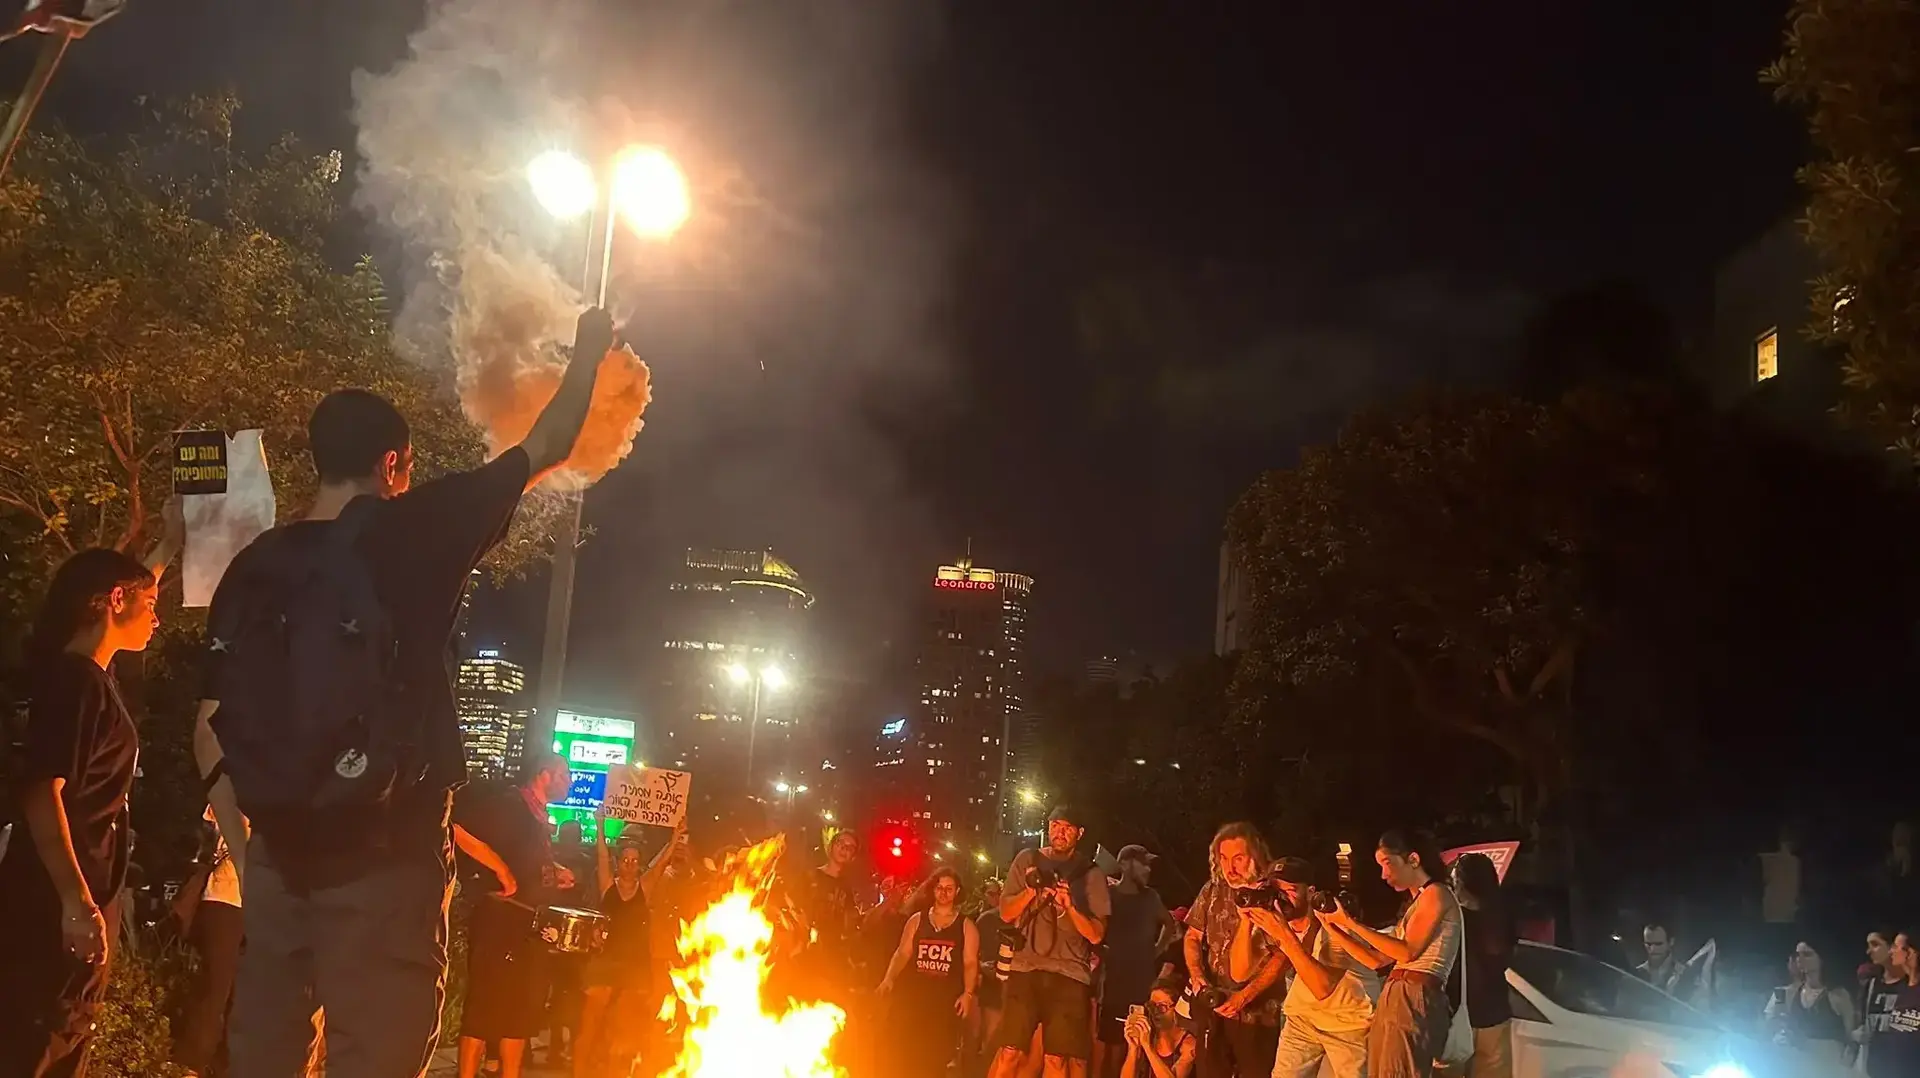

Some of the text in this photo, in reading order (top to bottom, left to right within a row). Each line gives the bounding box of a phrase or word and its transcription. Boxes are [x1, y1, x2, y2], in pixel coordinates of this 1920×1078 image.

[180, 445, 219, 461] ומה עם
[174, 466, 226, 481] החטופים?
[620, 783, 652, 797] מסתיר
[642, 810, 669, 825] בקצה
[917, 944, 953, 962] FCK
